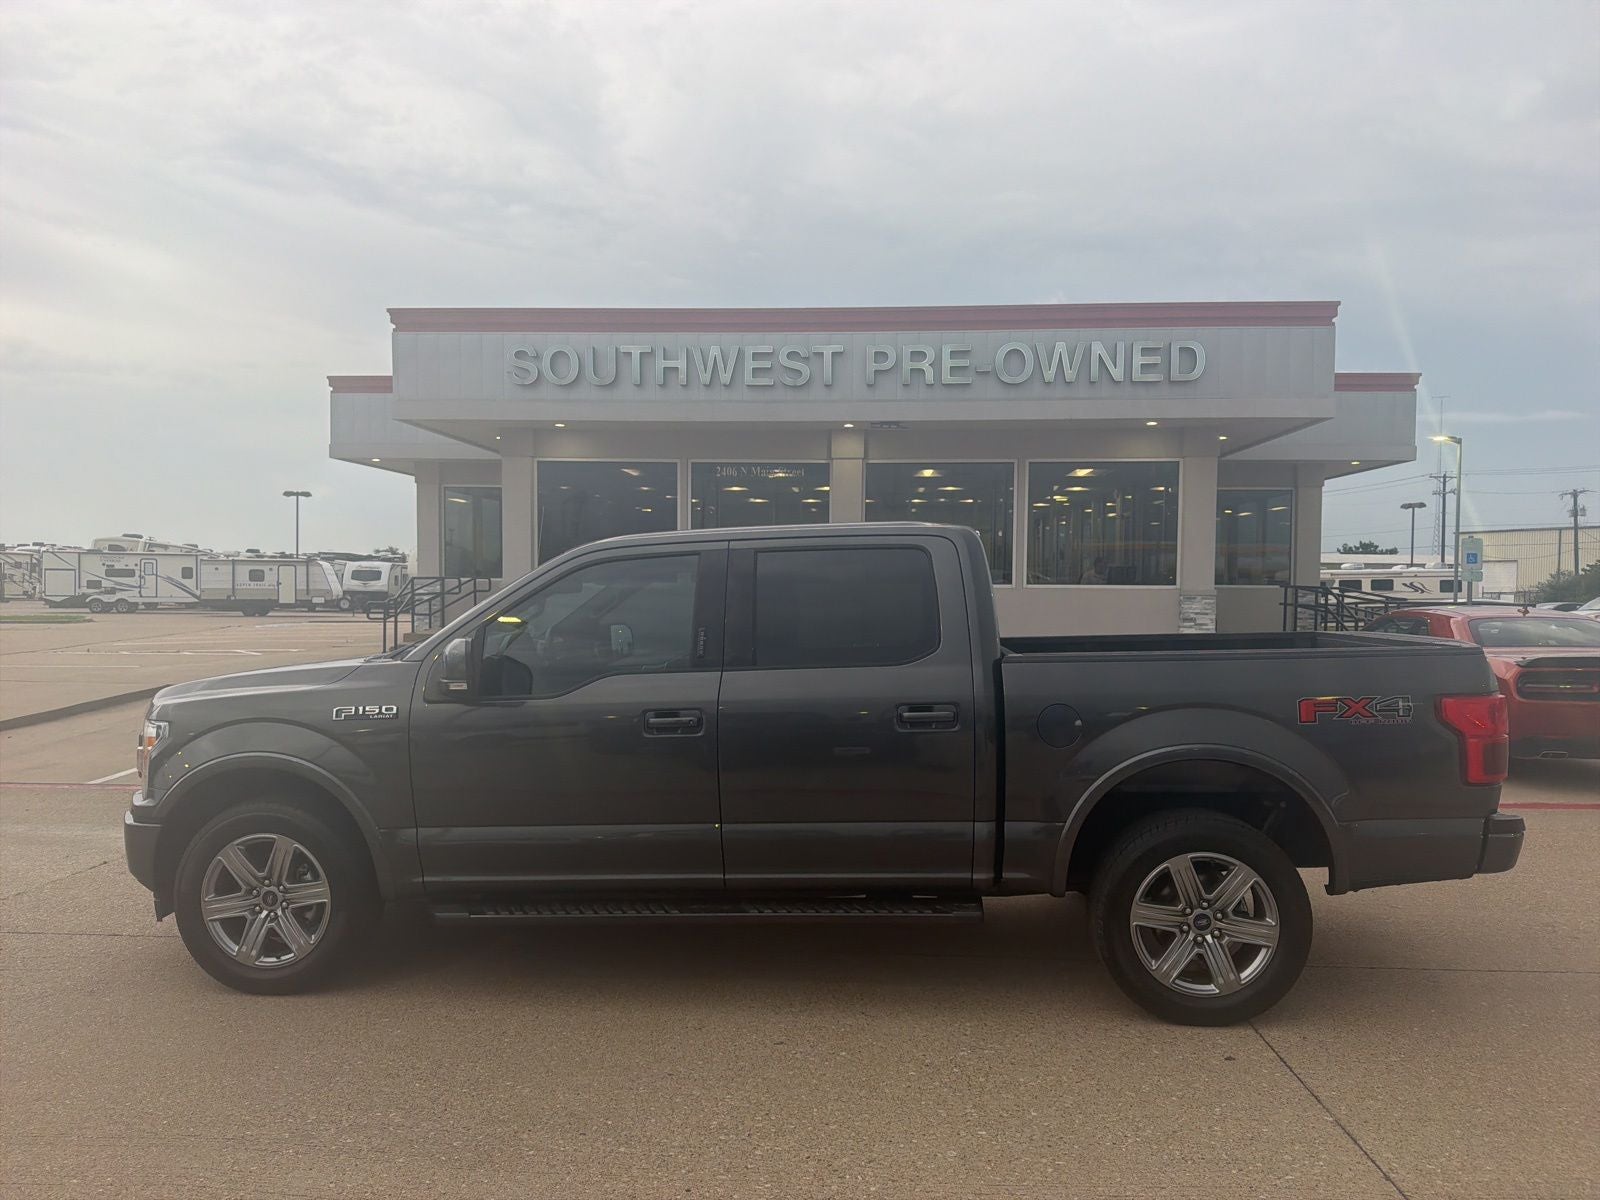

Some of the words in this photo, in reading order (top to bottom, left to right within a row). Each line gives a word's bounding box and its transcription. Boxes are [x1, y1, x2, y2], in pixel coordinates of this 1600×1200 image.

[507, 343, 844, 387] SOUTHWEST
[865, 340, 1207, 386] PRE-OWNED
[716, 466, 737, 477] 2406
[740, 466, 748, 477] N
[1297, 695, 1414, 725] FX4
